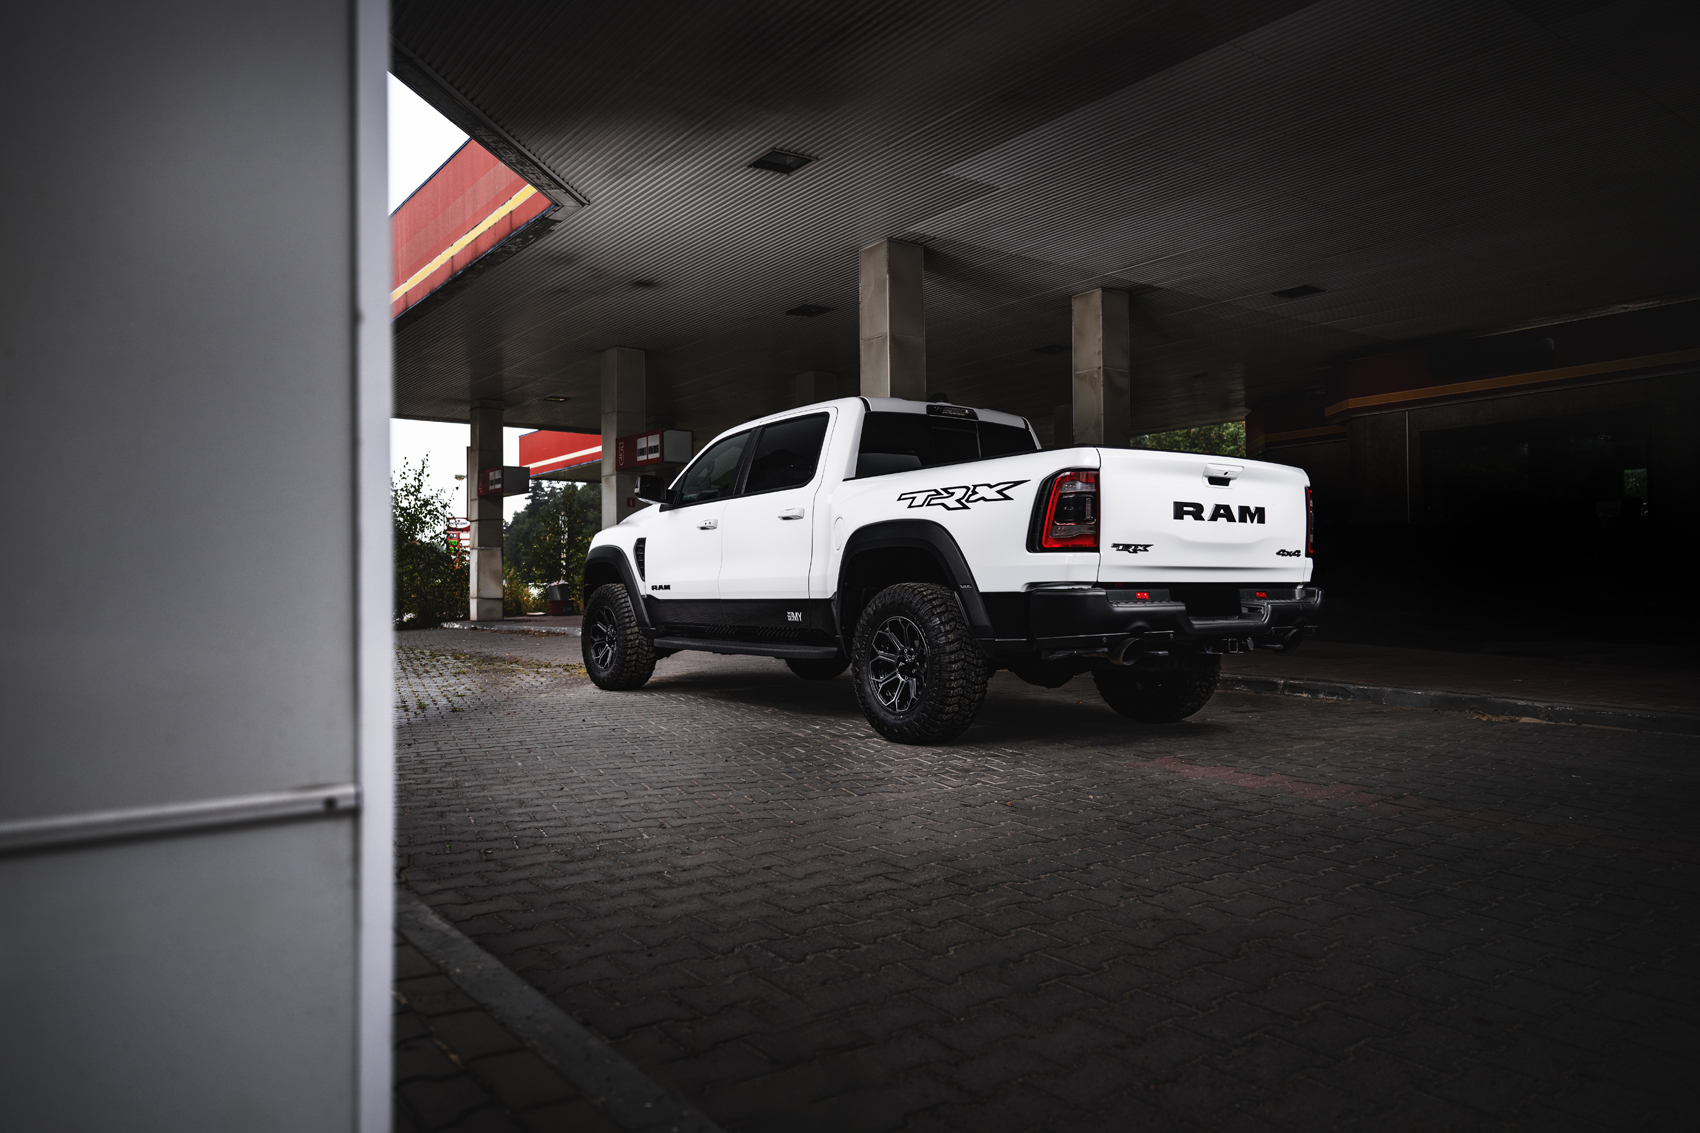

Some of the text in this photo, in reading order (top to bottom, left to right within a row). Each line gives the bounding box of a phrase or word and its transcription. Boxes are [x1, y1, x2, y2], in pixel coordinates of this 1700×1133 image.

[619, 441, 625, 466] 5
[897, 479, 1031, 511] TRX
[1173, 501, 1265, 524] RAM
[1111, 543, 1154, 554] TRX
[1276, 549, 1301, 557] 4x4
